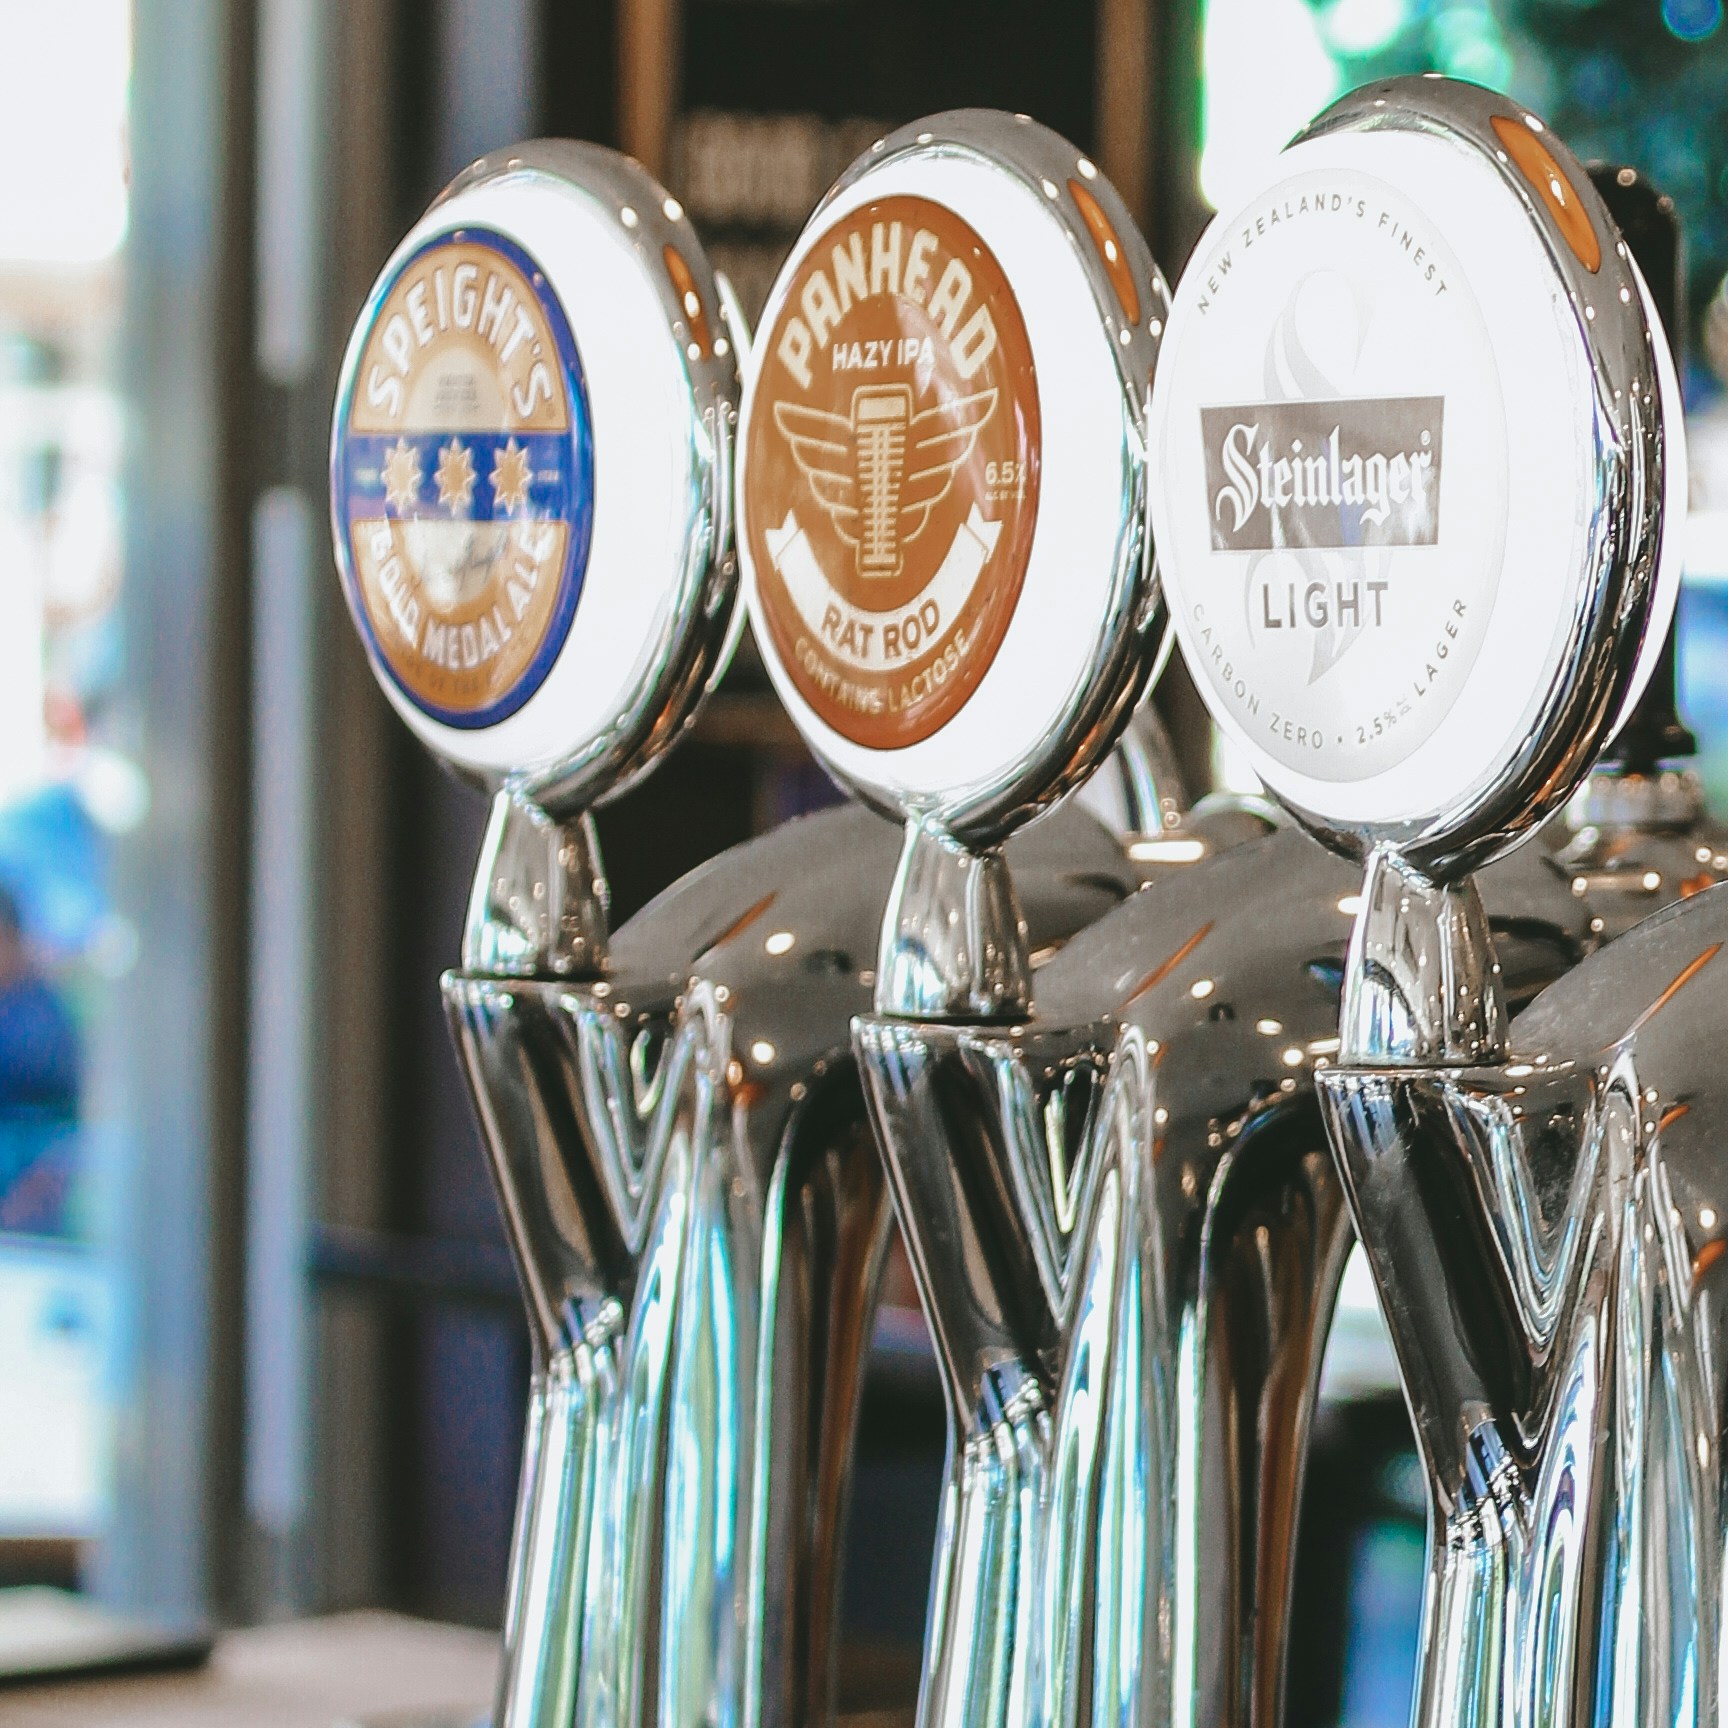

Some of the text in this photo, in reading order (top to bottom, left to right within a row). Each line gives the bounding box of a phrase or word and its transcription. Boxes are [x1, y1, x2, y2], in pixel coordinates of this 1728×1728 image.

[1198, 193, 1447, 315] NEW ZEALAND'S FINEST
[367, 263, 552, 419] SPEIGHT'S
[777, 222, 997, 390] PANHEAD
[833, 336, 936, 372] HAZY IPA
[1215, 423, 1432, 533] Steinlager
[422, 605, 512, 671] MEDAL
[822, 598, 940, 659] RAT ROD
[1263, 581, 1388, 628] LIGHT
[795, 627, 970, 714] CONTAINS LACTOSE
[1193, 603, 1260, 715] CARBON
[1270, 712, 1323, 749] ZERO
[1414, 599, 1467, 697] LAGER
